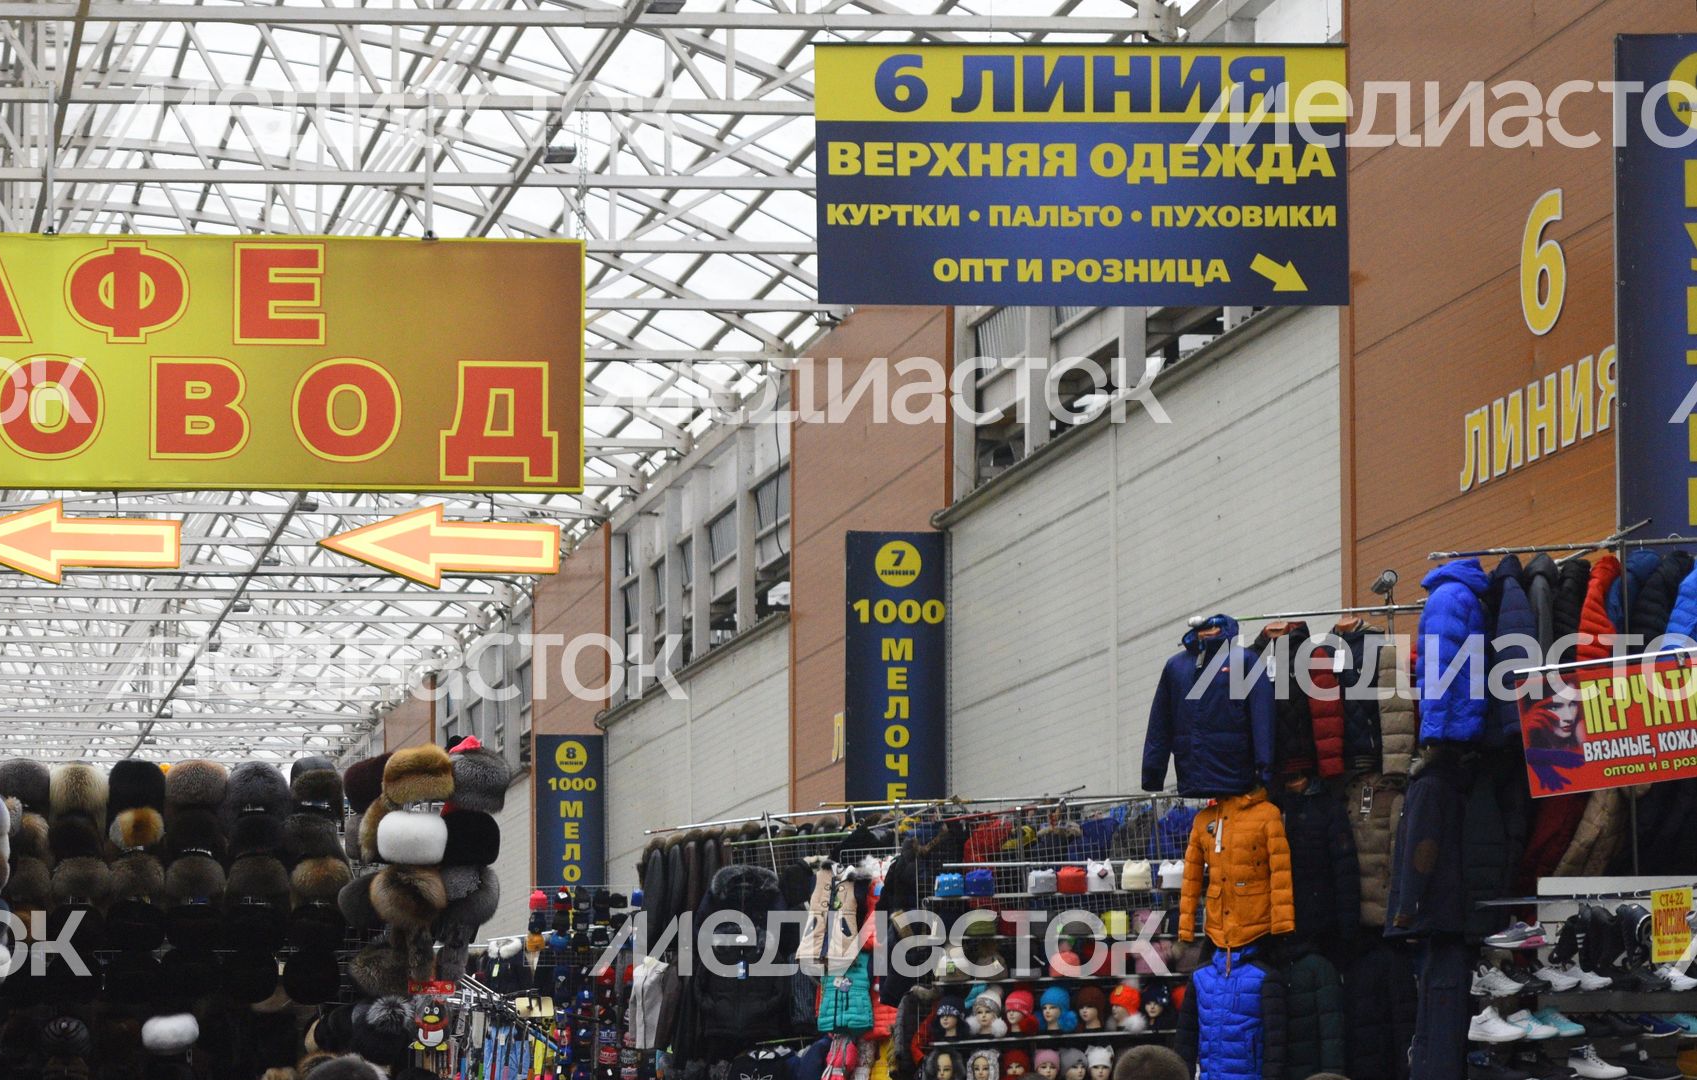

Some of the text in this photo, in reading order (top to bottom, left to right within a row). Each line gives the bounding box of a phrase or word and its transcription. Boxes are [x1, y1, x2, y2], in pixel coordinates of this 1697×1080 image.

[874, 54, 1287, 114] 6 ЛИНИЯ
[827, 141, 1336, 184] ВЕРХНЯЯ ОДЕЖДА
[826, 204, 1337, 227] КУРТКИ ПАЛЬТО ПУХОВИКИ
[933, 257, 1231, 289] ОПТ И РОЗНИЦА
[1520, 188, 1567, 337] 6
[891, 550, 906, 566] 7
[852, 598, 946, 625] 1000
[881, 637, 914, 806] МЕЛОЧЕ
[566, 748, 576, 759] 8
[1583, 733, 1657, 763] ВЯЗАНЫЕ,
[1604, 762, 1646, 777] оптом
[1649, 760, 1658, 772] и
[1661, 759, 1671, 770] в
[548, 777, 597, 791] 1000
